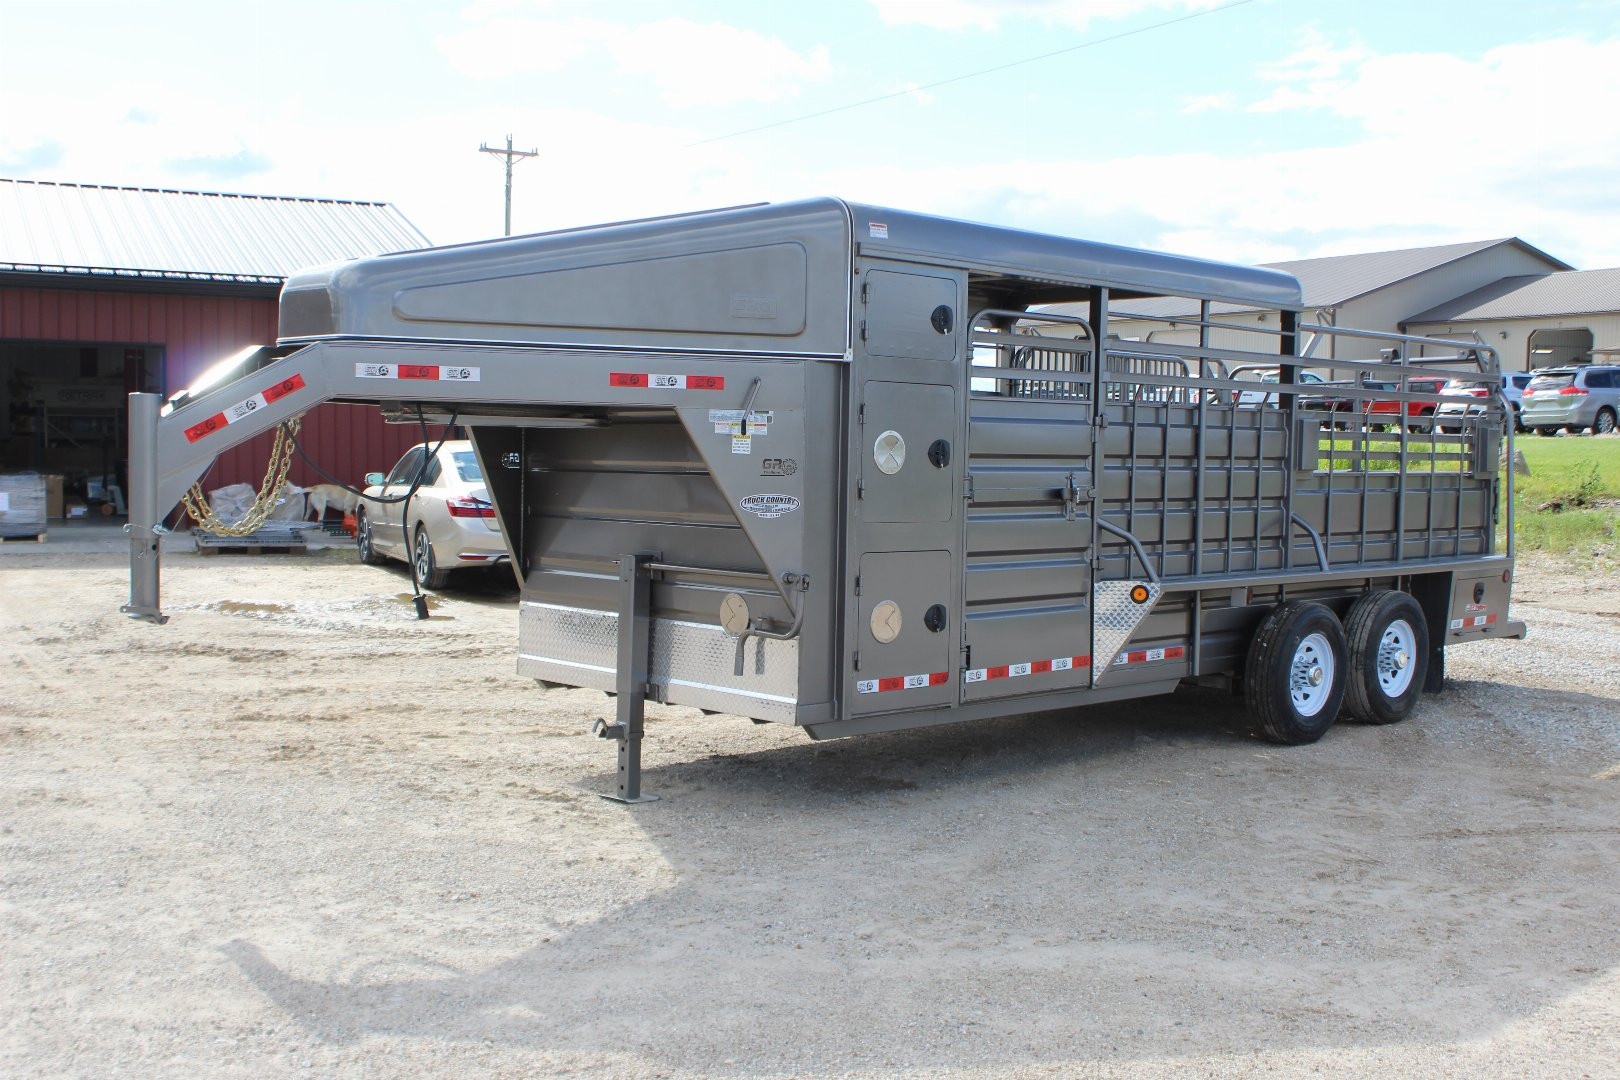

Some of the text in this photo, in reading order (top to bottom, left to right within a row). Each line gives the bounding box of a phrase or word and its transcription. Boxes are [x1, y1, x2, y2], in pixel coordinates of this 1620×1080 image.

[763, 458, 782, 470] GR
[743, 496, 796, 505] TRUCK COUNTRY
